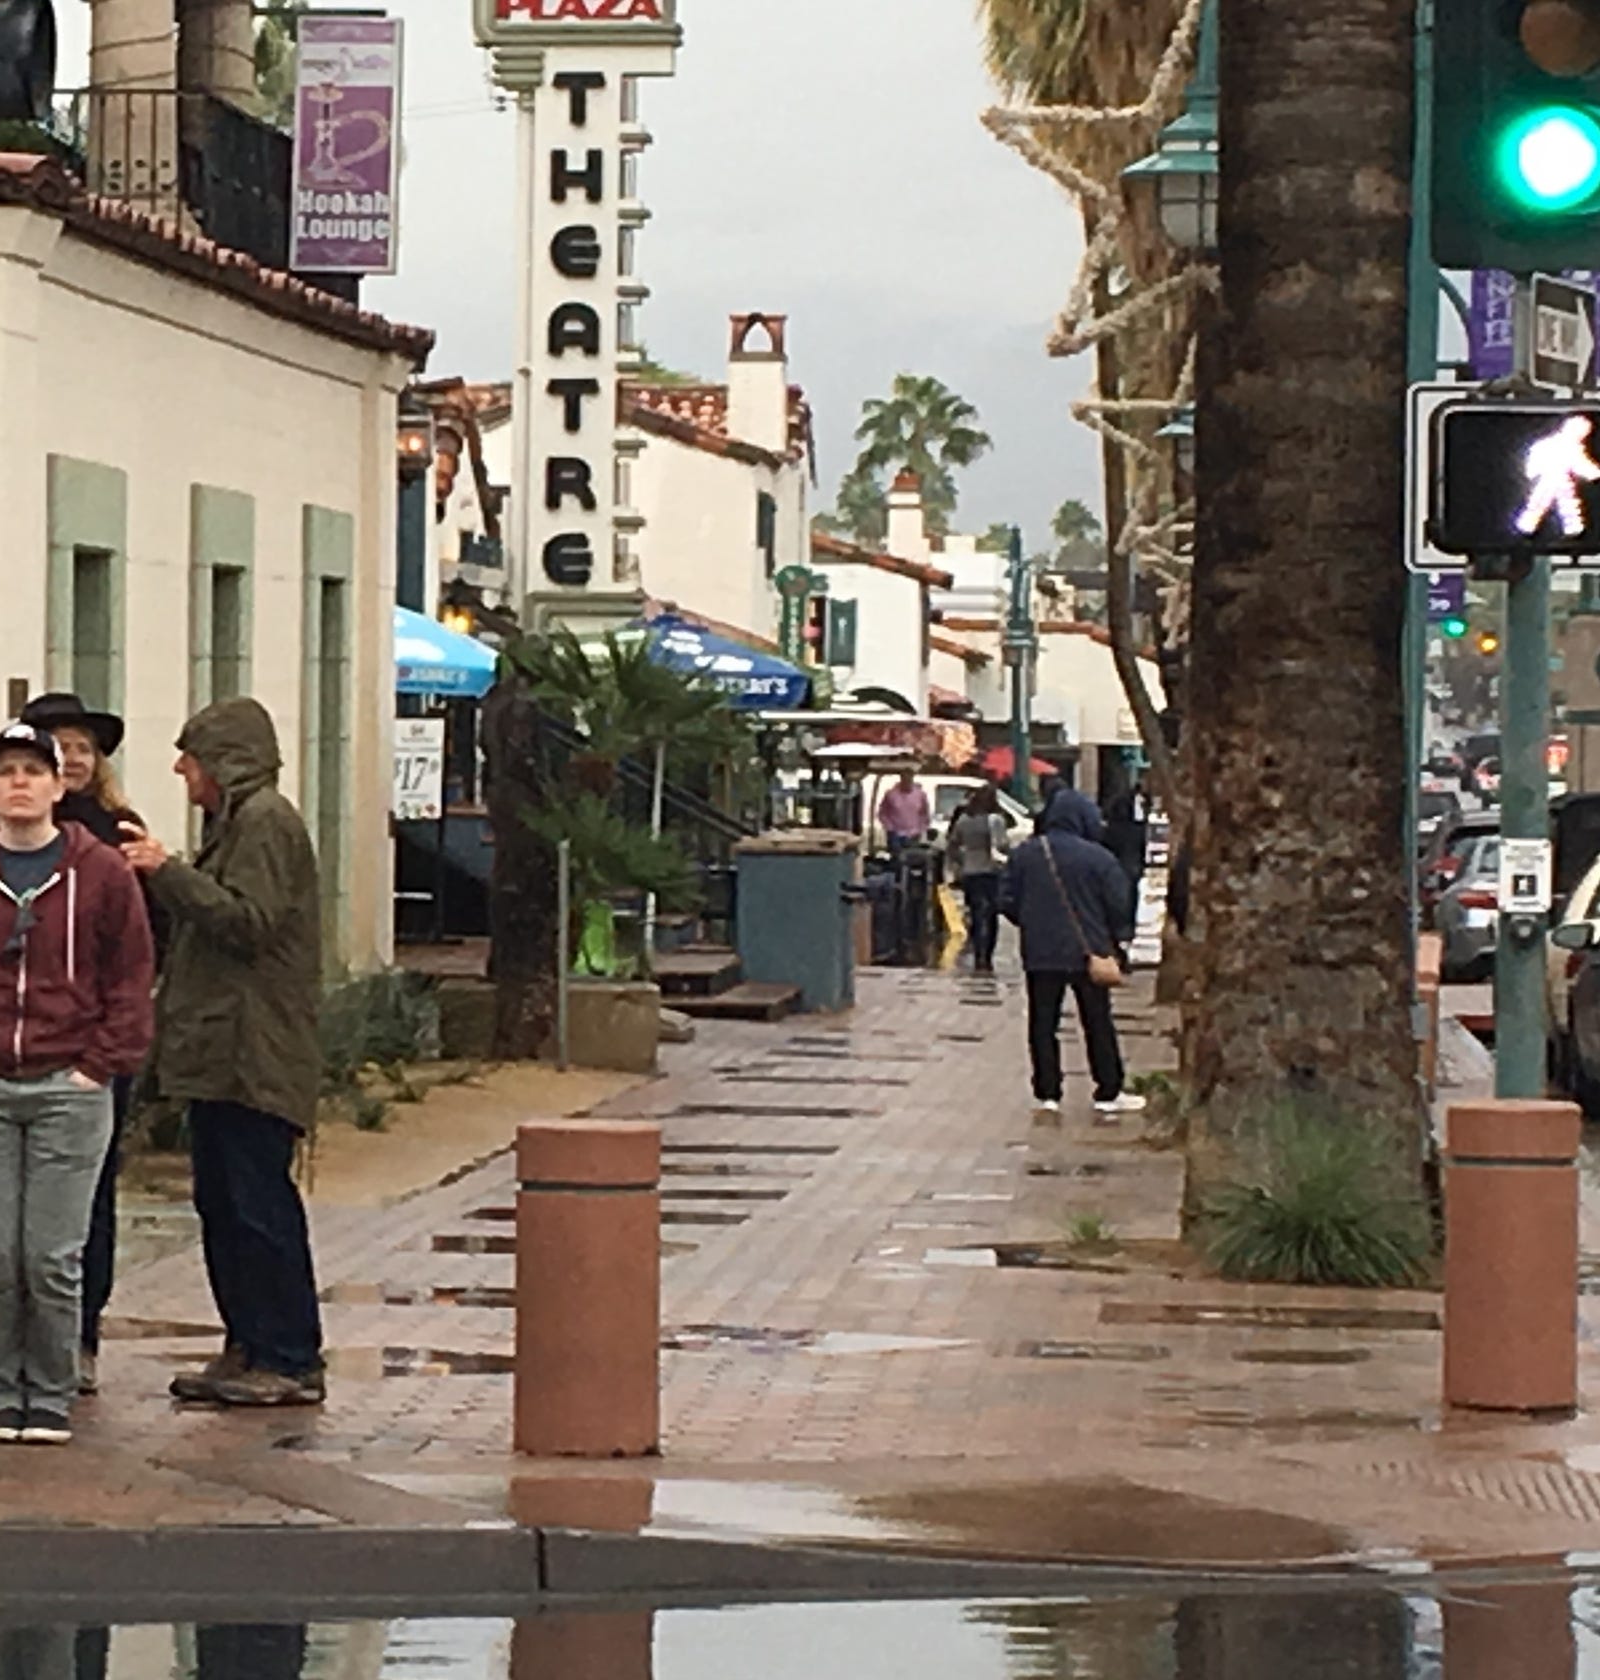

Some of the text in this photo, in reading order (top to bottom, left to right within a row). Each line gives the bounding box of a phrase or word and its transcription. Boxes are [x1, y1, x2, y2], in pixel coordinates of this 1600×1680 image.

[494, 0, 663, 20] PLAZA
[297, 189, 390, 215] Hookah
[296, 215, 392, 242] Lounge
[542, 70, 606, 587] THEATRE
